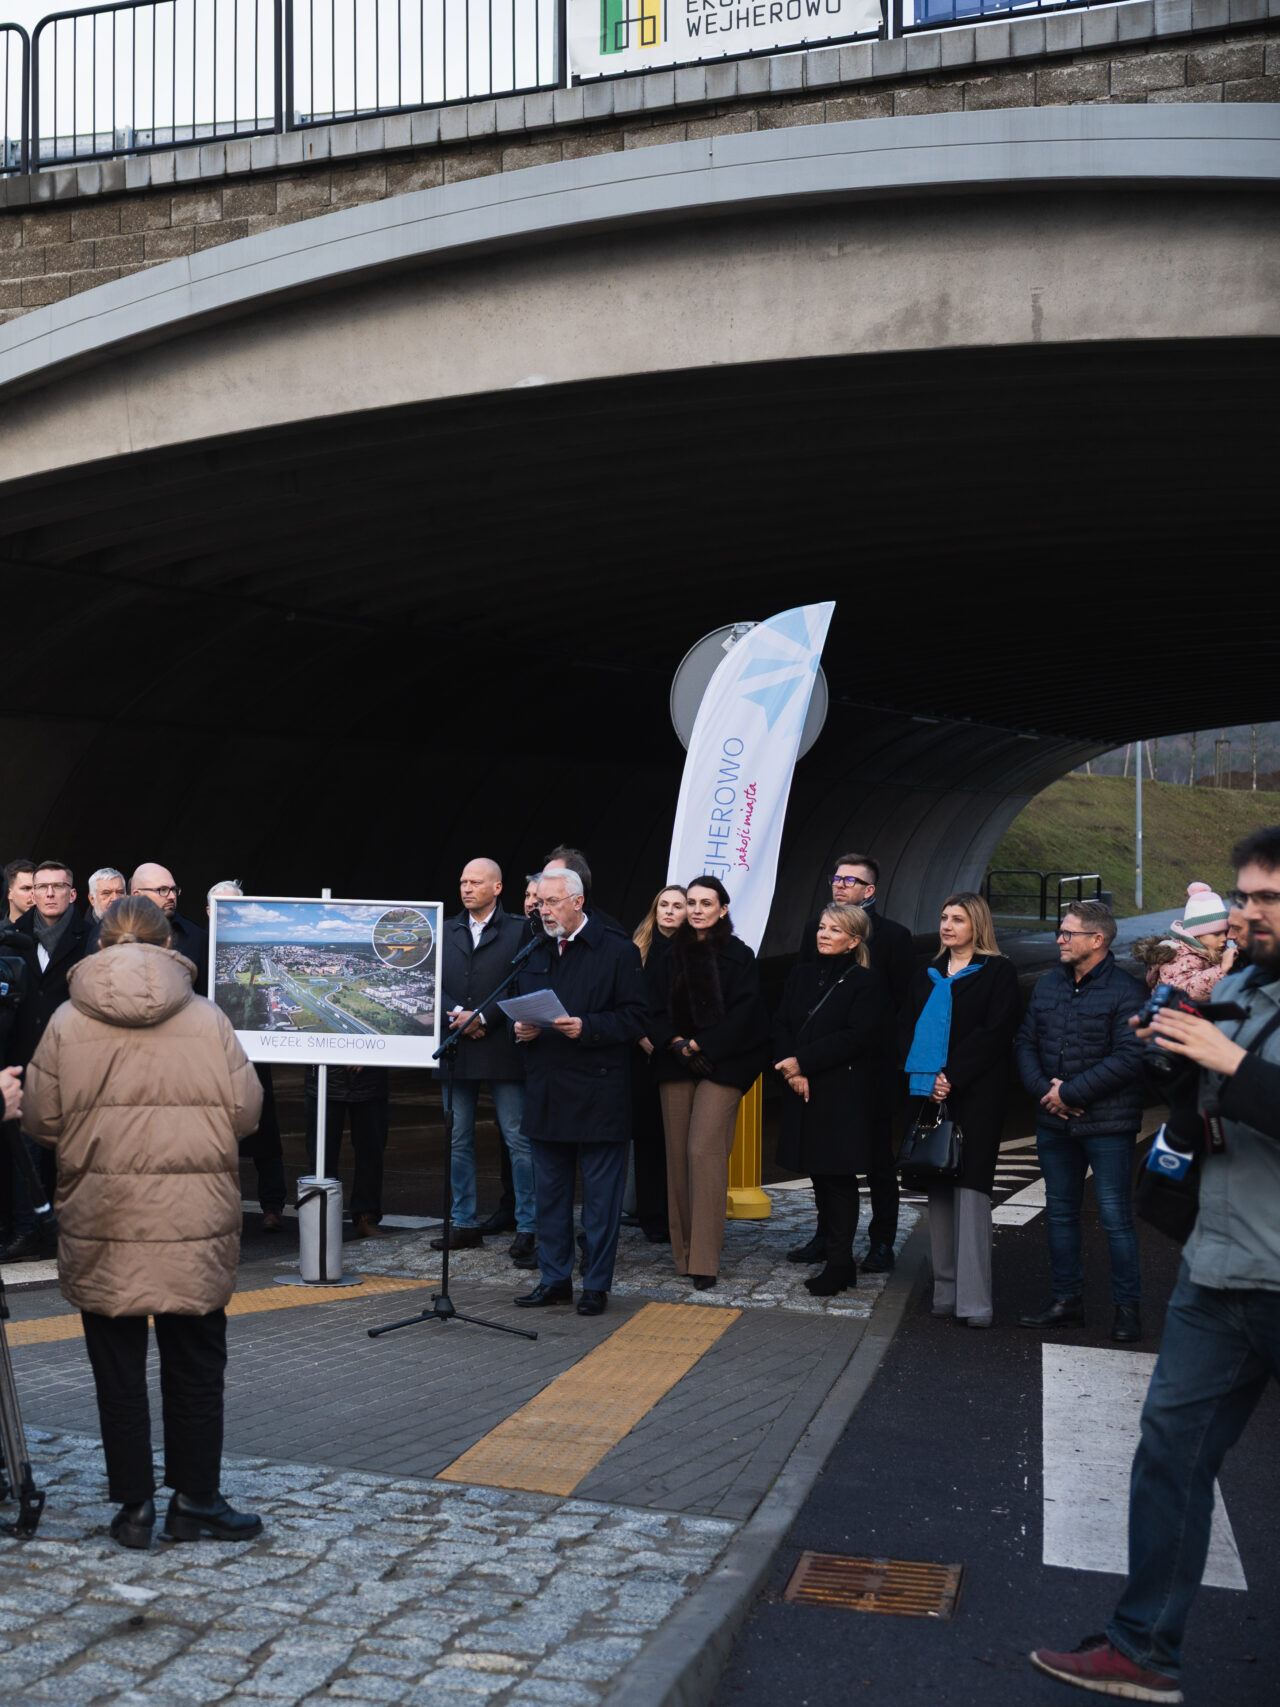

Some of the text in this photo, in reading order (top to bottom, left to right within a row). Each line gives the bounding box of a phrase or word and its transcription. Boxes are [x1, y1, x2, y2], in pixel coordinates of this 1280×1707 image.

[686, 0, 841, 37] WEJHEROWO
[703, 737, 744, 881] EJHEROWO
[733, 781, 757, 871] jakość miasta
[260, 1035, 386, 1050] WĘZEŁ ŚMIECHOWO
